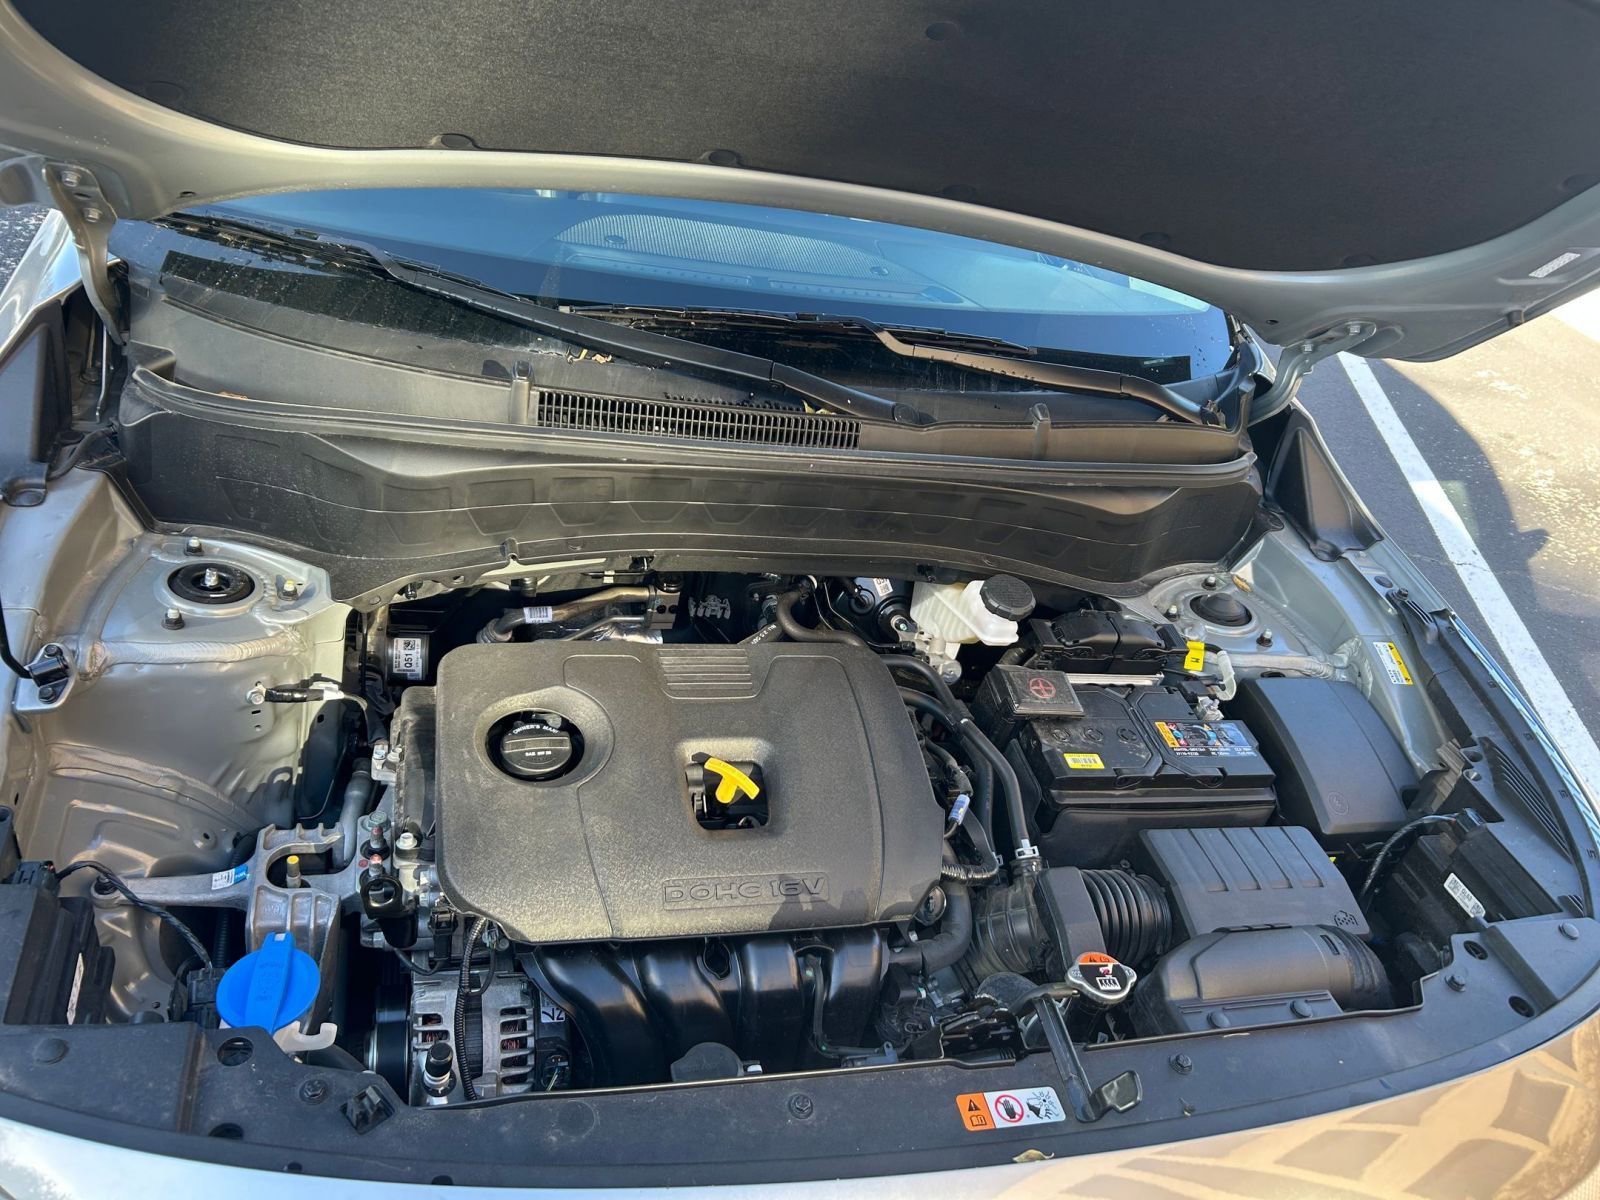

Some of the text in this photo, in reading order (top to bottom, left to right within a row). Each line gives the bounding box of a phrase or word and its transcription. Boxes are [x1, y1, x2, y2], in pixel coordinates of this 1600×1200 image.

[404, 653, 413, 669] Q51
[664, 876, 827, 903] DOHC 16V
